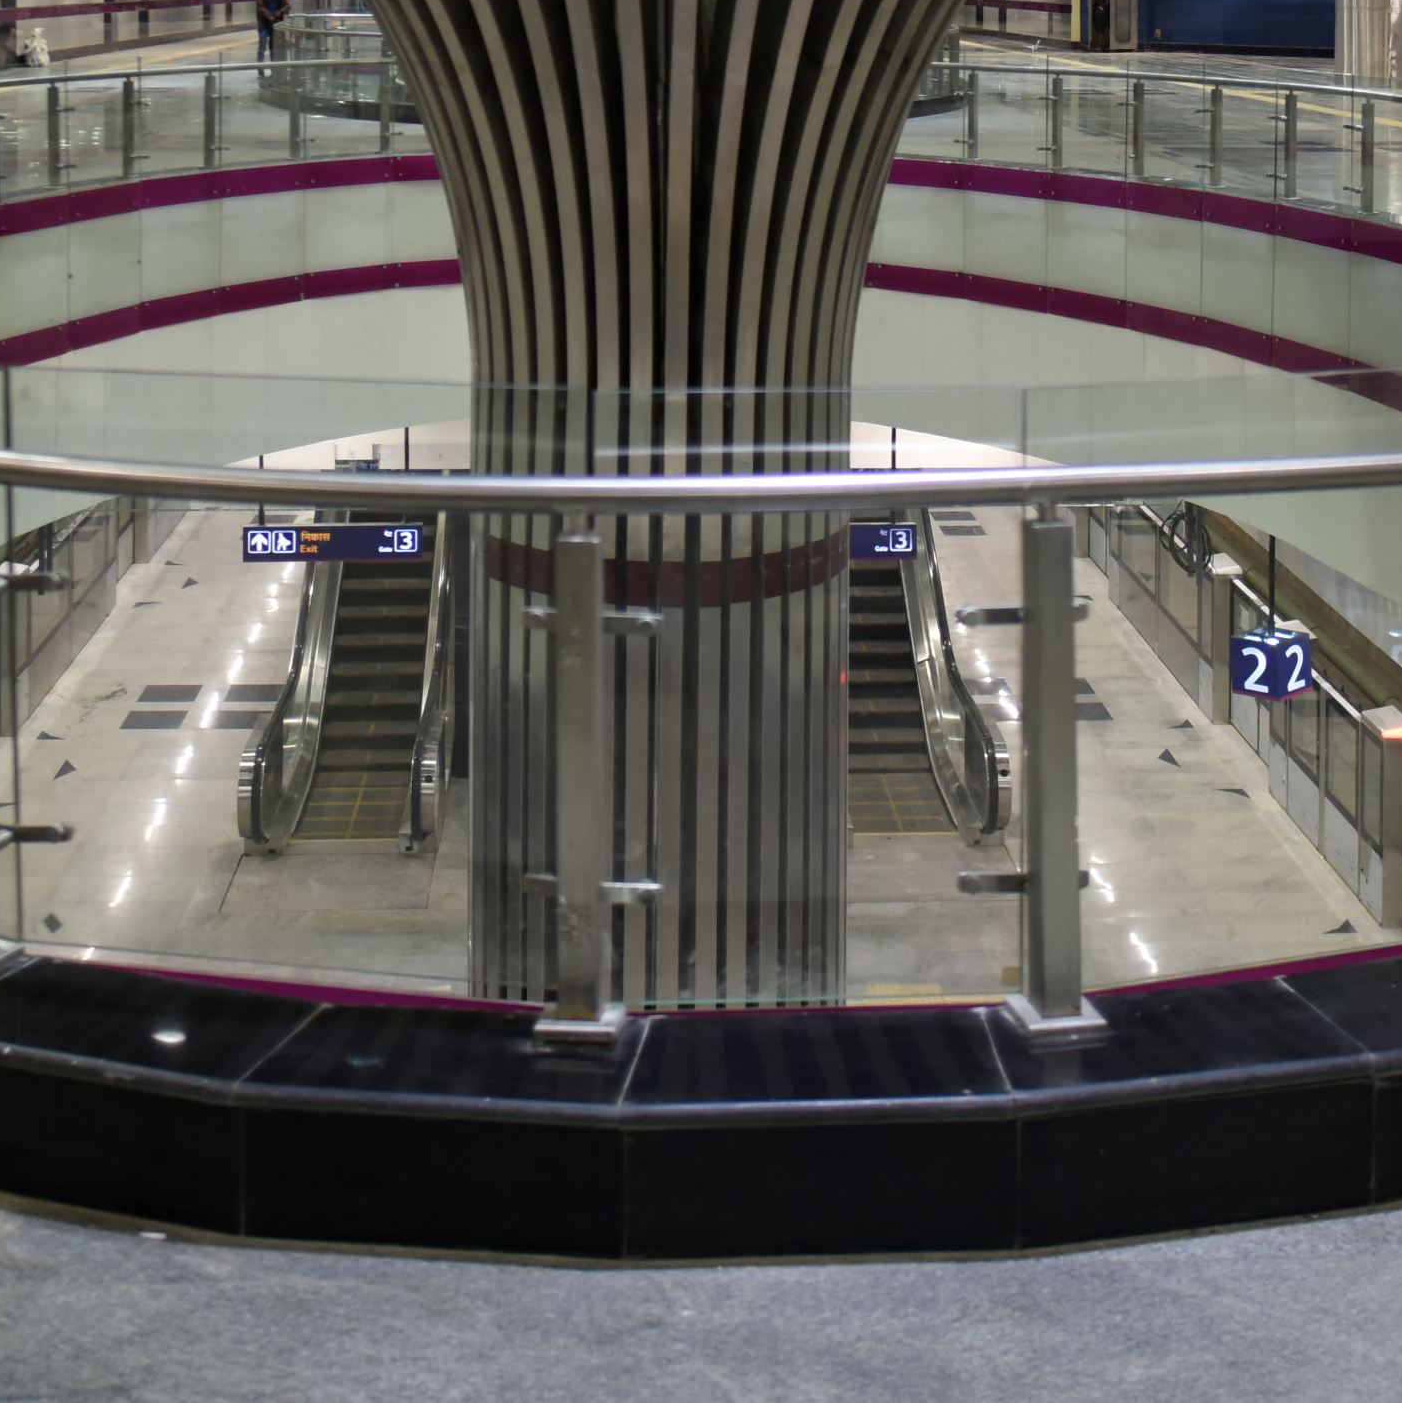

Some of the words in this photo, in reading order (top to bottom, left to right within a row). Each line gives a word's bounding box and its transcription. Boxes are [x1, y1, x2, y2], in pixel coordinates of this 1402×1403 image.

[300, 531, 331, 542] निकास
[399, 532, 413, 550] 3
[894, 531, 908, 549] 3
[299, 544, 319, 553] Exit
[1241, 645, 1270, 694] 2
[1285, 644, 1306, 692] 2
